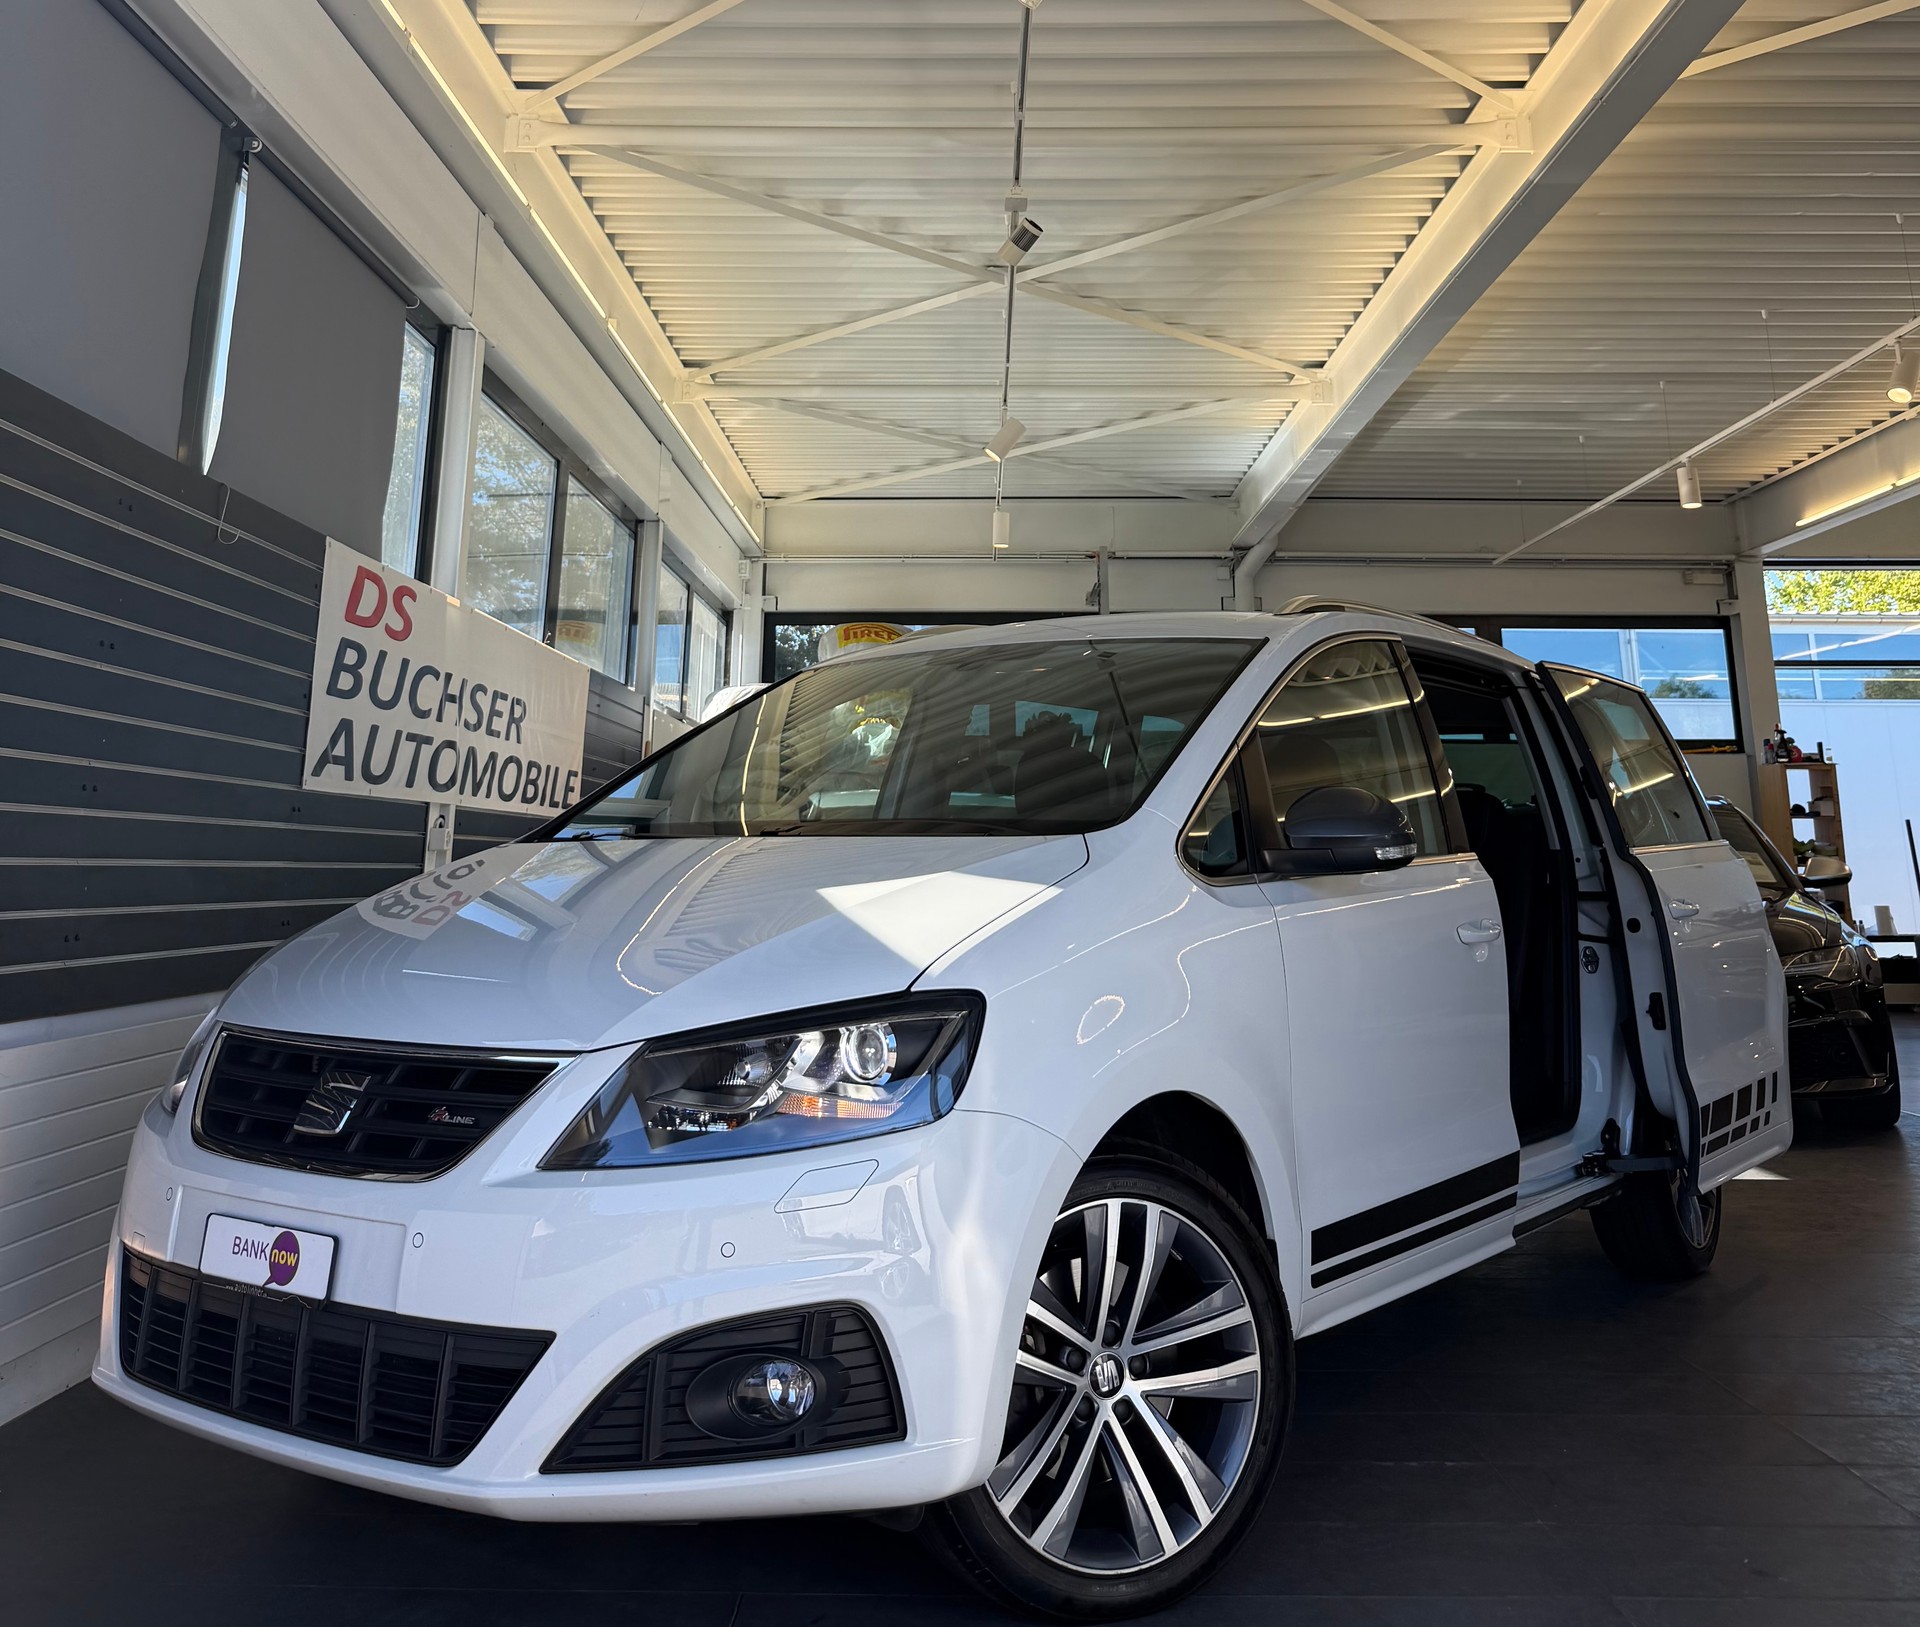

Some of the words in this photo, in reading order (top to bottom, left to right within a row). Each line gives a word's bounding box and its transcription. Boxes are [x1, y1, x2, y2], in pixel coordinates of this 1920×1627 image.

[345, 565, 417, 641] DS
[326, 637, 527, 744] BUCHSER
[311, 718, 578, 810] AUTOMOBILE
[232, 1236, 269, 1261] BANK
[271, 1249, 298, 1267] now
